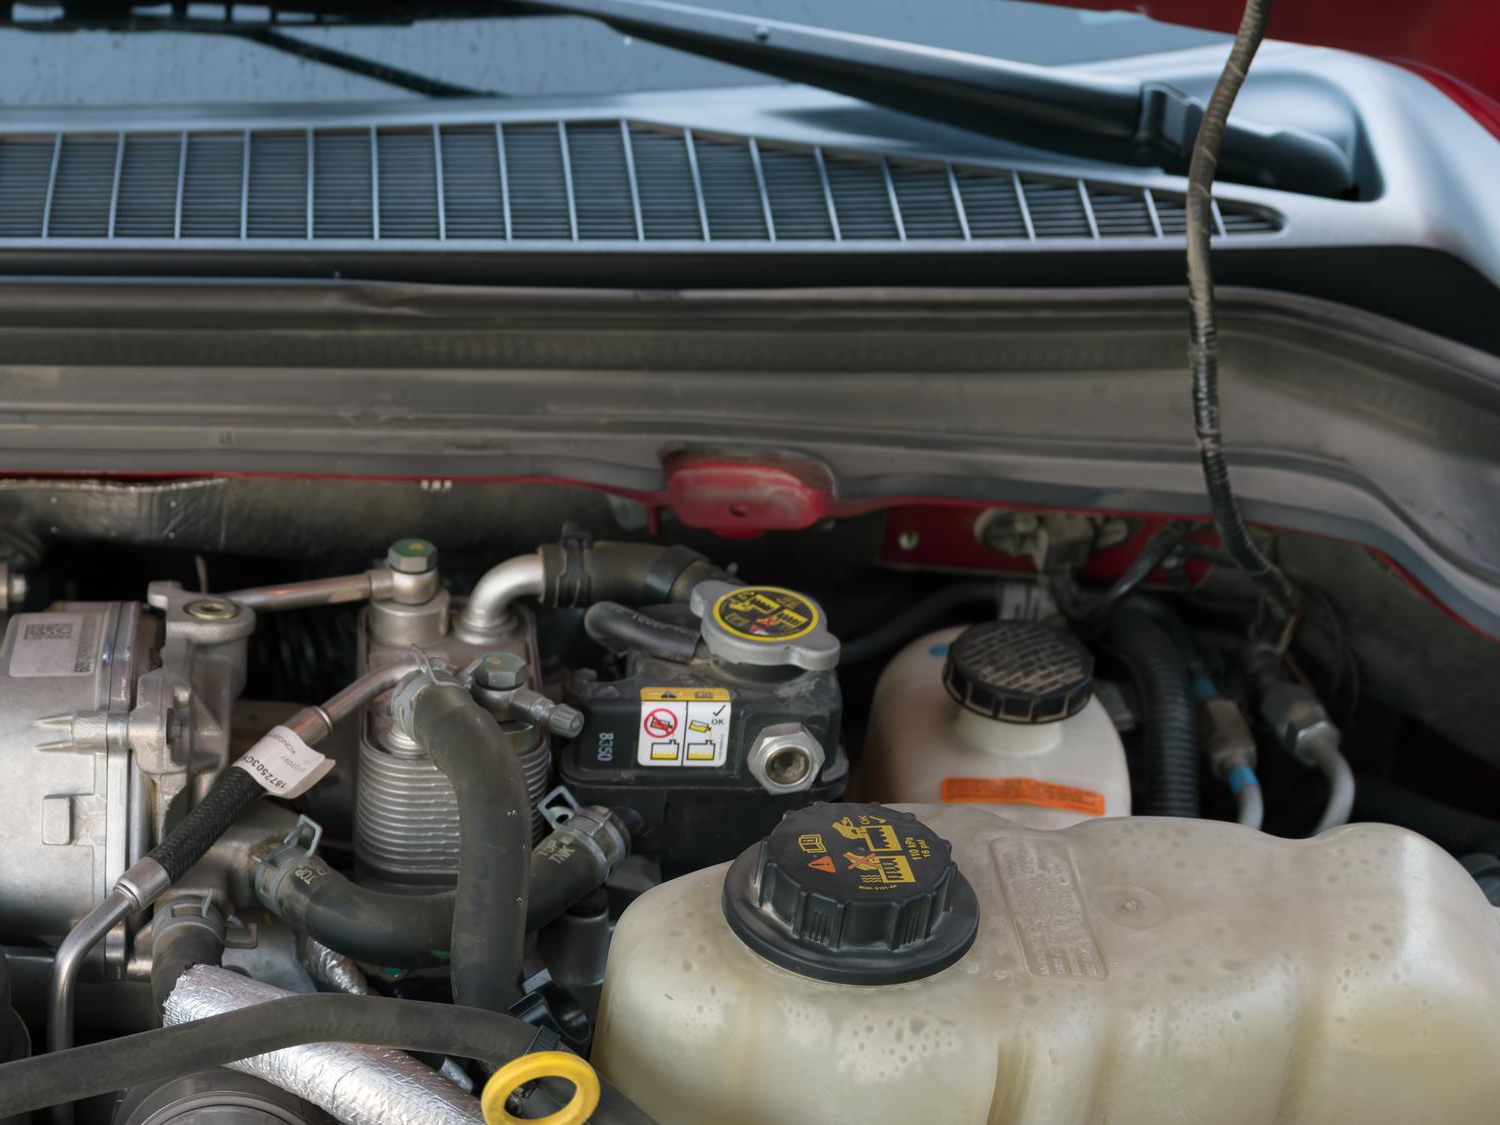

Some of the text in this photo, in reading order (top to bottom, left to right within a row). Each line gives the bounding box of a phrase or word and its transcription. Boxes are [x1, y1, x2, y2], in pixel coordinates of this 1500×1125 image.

[711, 717, 725, 726] OK
[597, 732, 614, 762] 8350
[858, 815, 870, 825] OK
